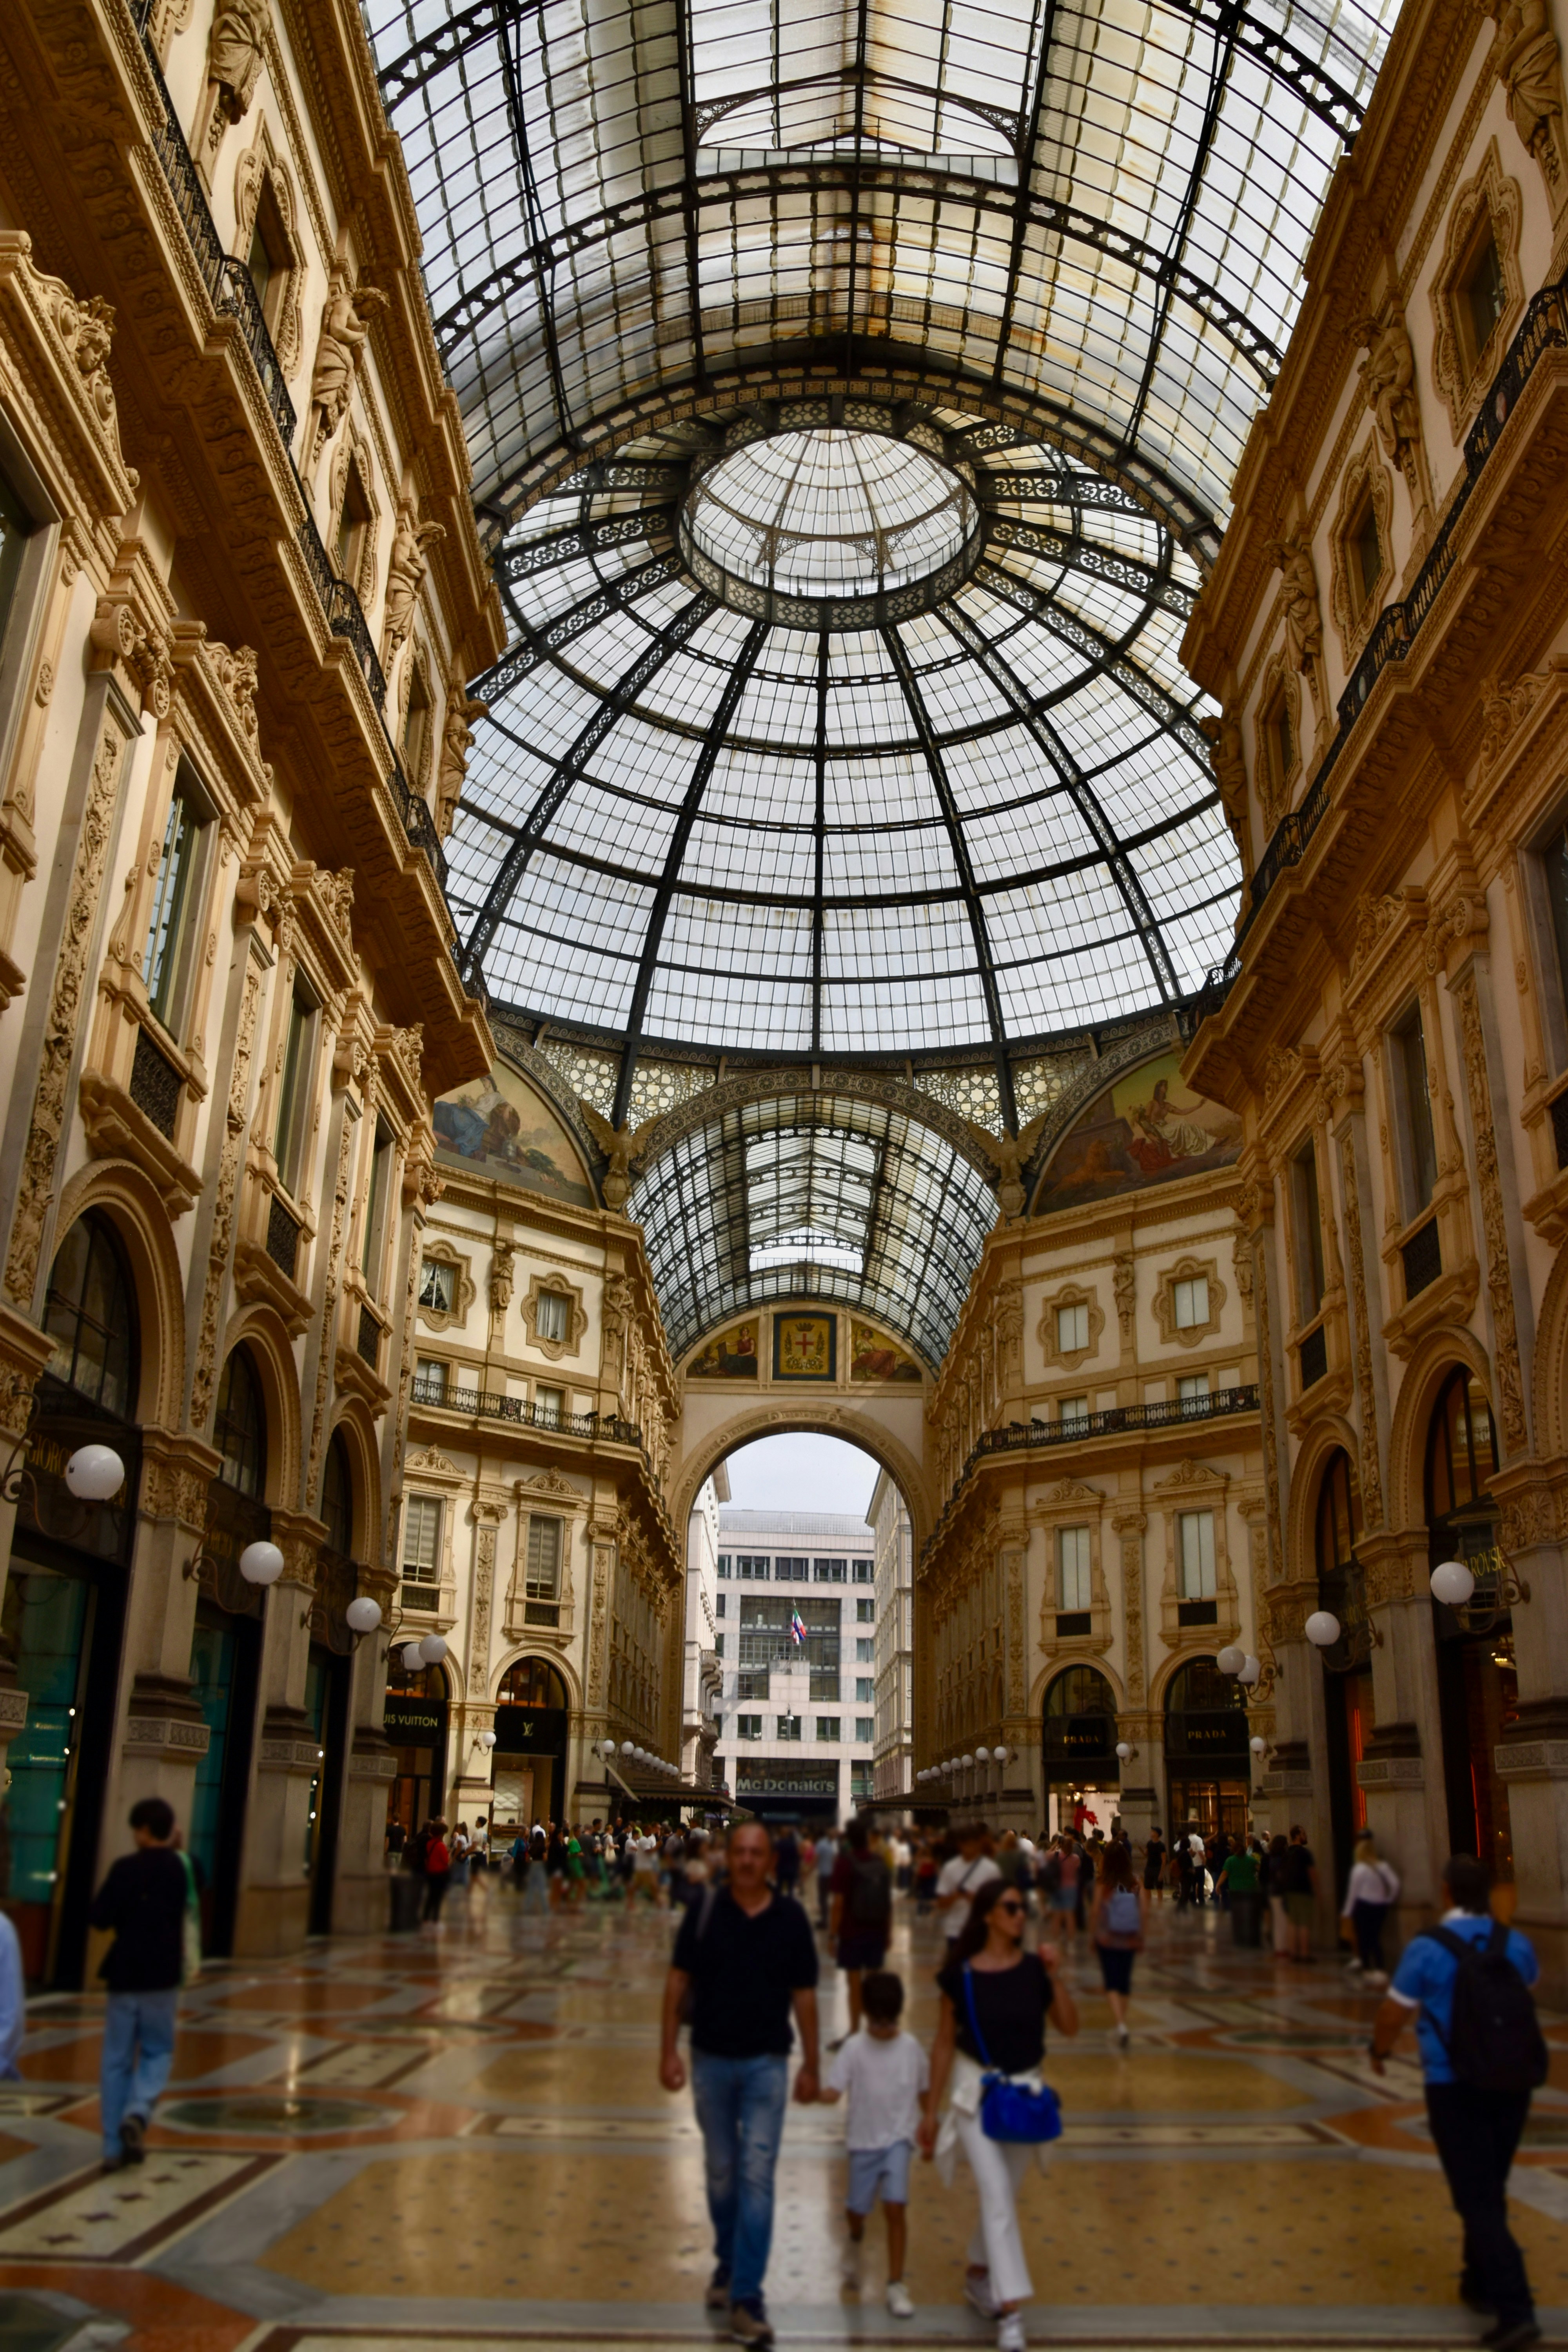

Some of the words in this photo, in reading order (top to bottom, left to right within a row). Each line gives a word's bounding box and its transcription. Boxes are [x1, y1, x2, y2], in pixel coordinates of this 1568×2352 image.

[26, 1430, 73, 1479] GIORG
[398, 1715, 438, 1728] VUITTON
[1063, 1735, 1099, 1744] PRADA
[1188, 1730, 1227, 1739] PRADA
[736, 1778, 836, 1792] McDonald's
